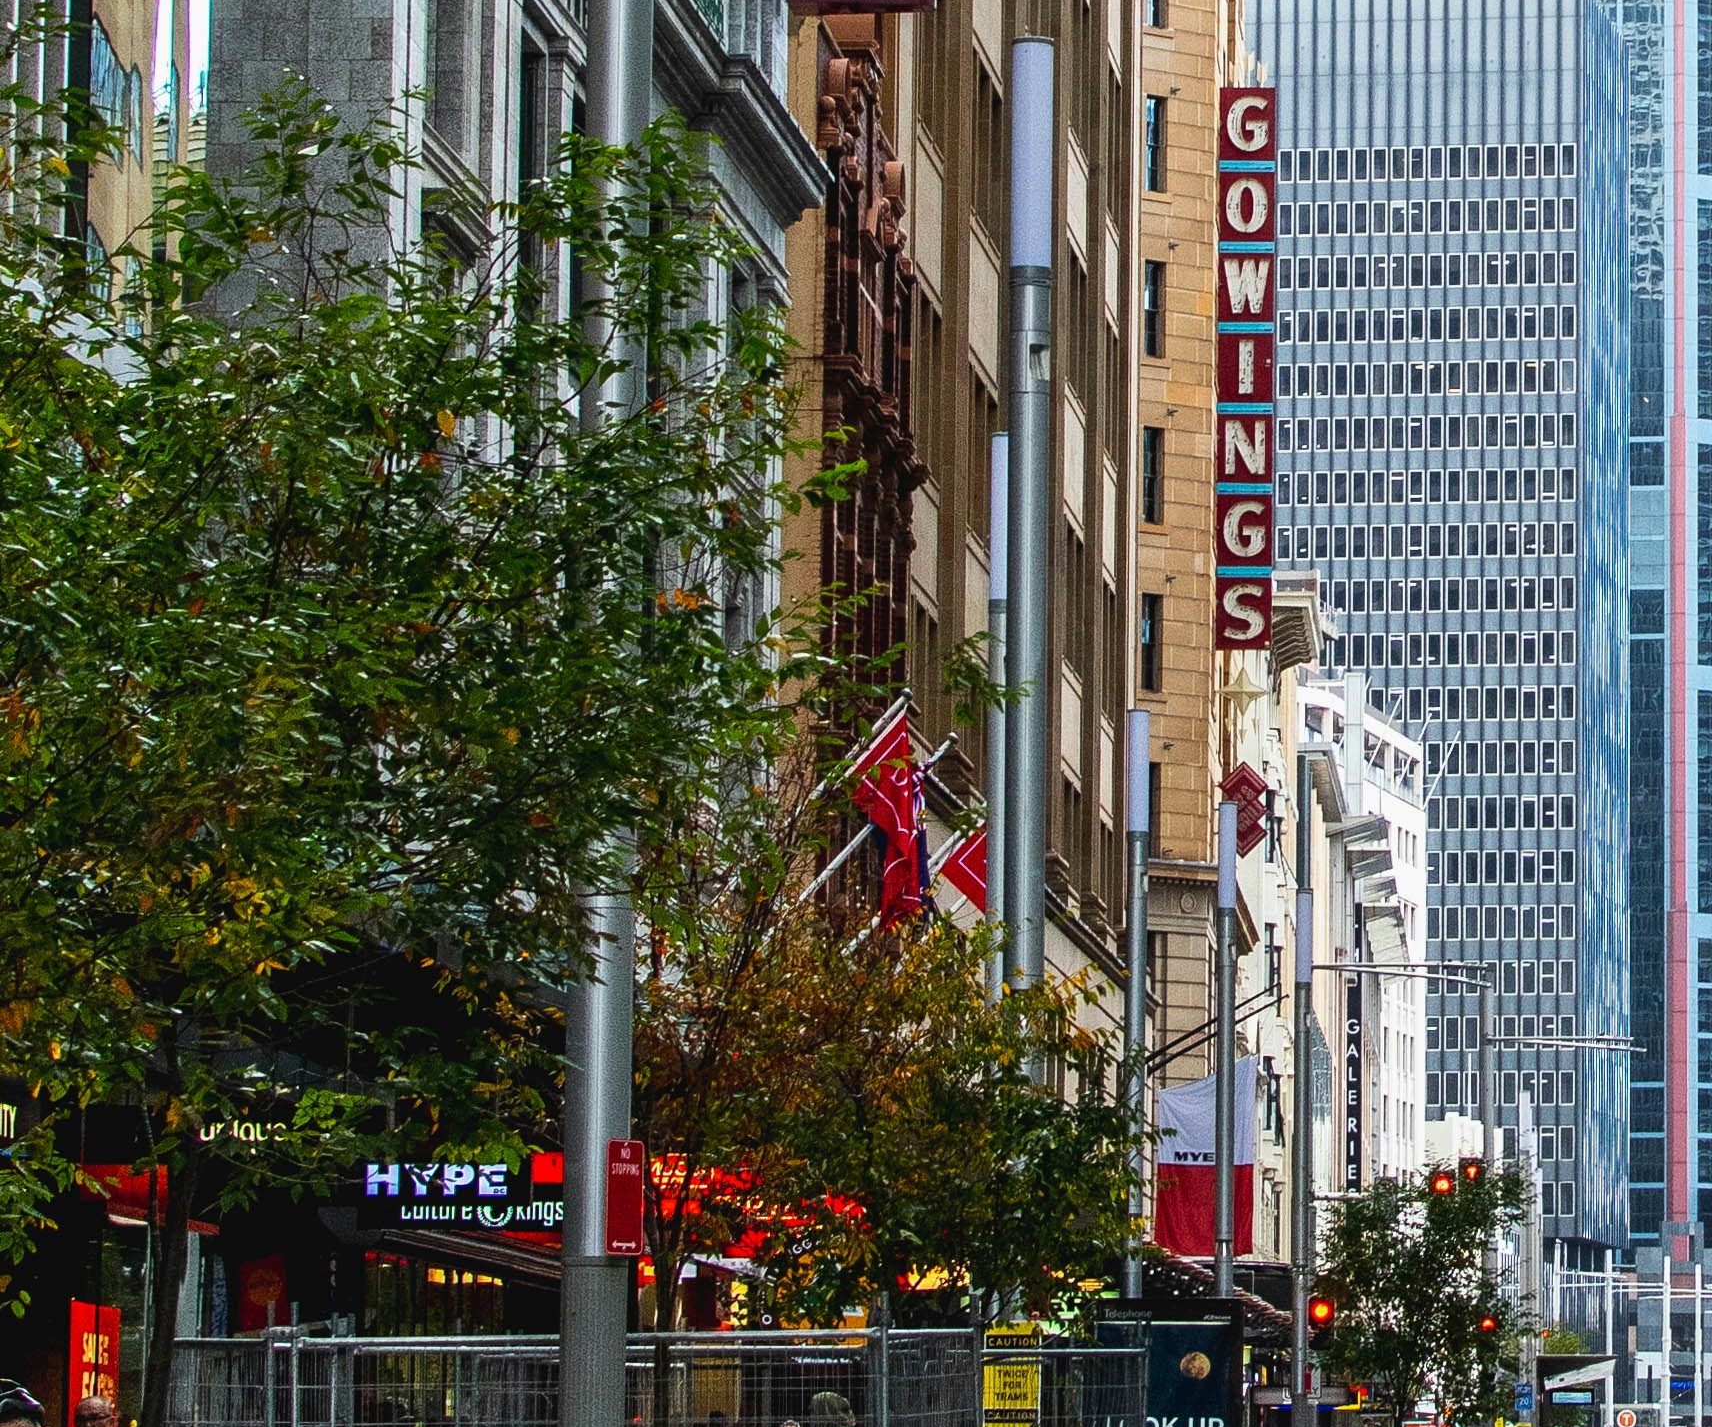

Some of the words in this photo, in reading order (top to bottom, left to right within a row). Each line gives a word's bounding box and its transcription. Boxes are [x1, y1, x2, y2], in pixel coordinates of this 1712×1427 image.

[1222, 95, 1269, 643] GOWINGS
[1346, 1019, 1360, 1194] GALERIE
[621, 1148, 631, 1159] NO
[1174, 1151, 1215, 1162] MYE
[611, 1162, 640, 1176] STOPPING
[365, 1163, 508, 1196] HYPE
[988, 1337, 1038, 1348] CAUTION
